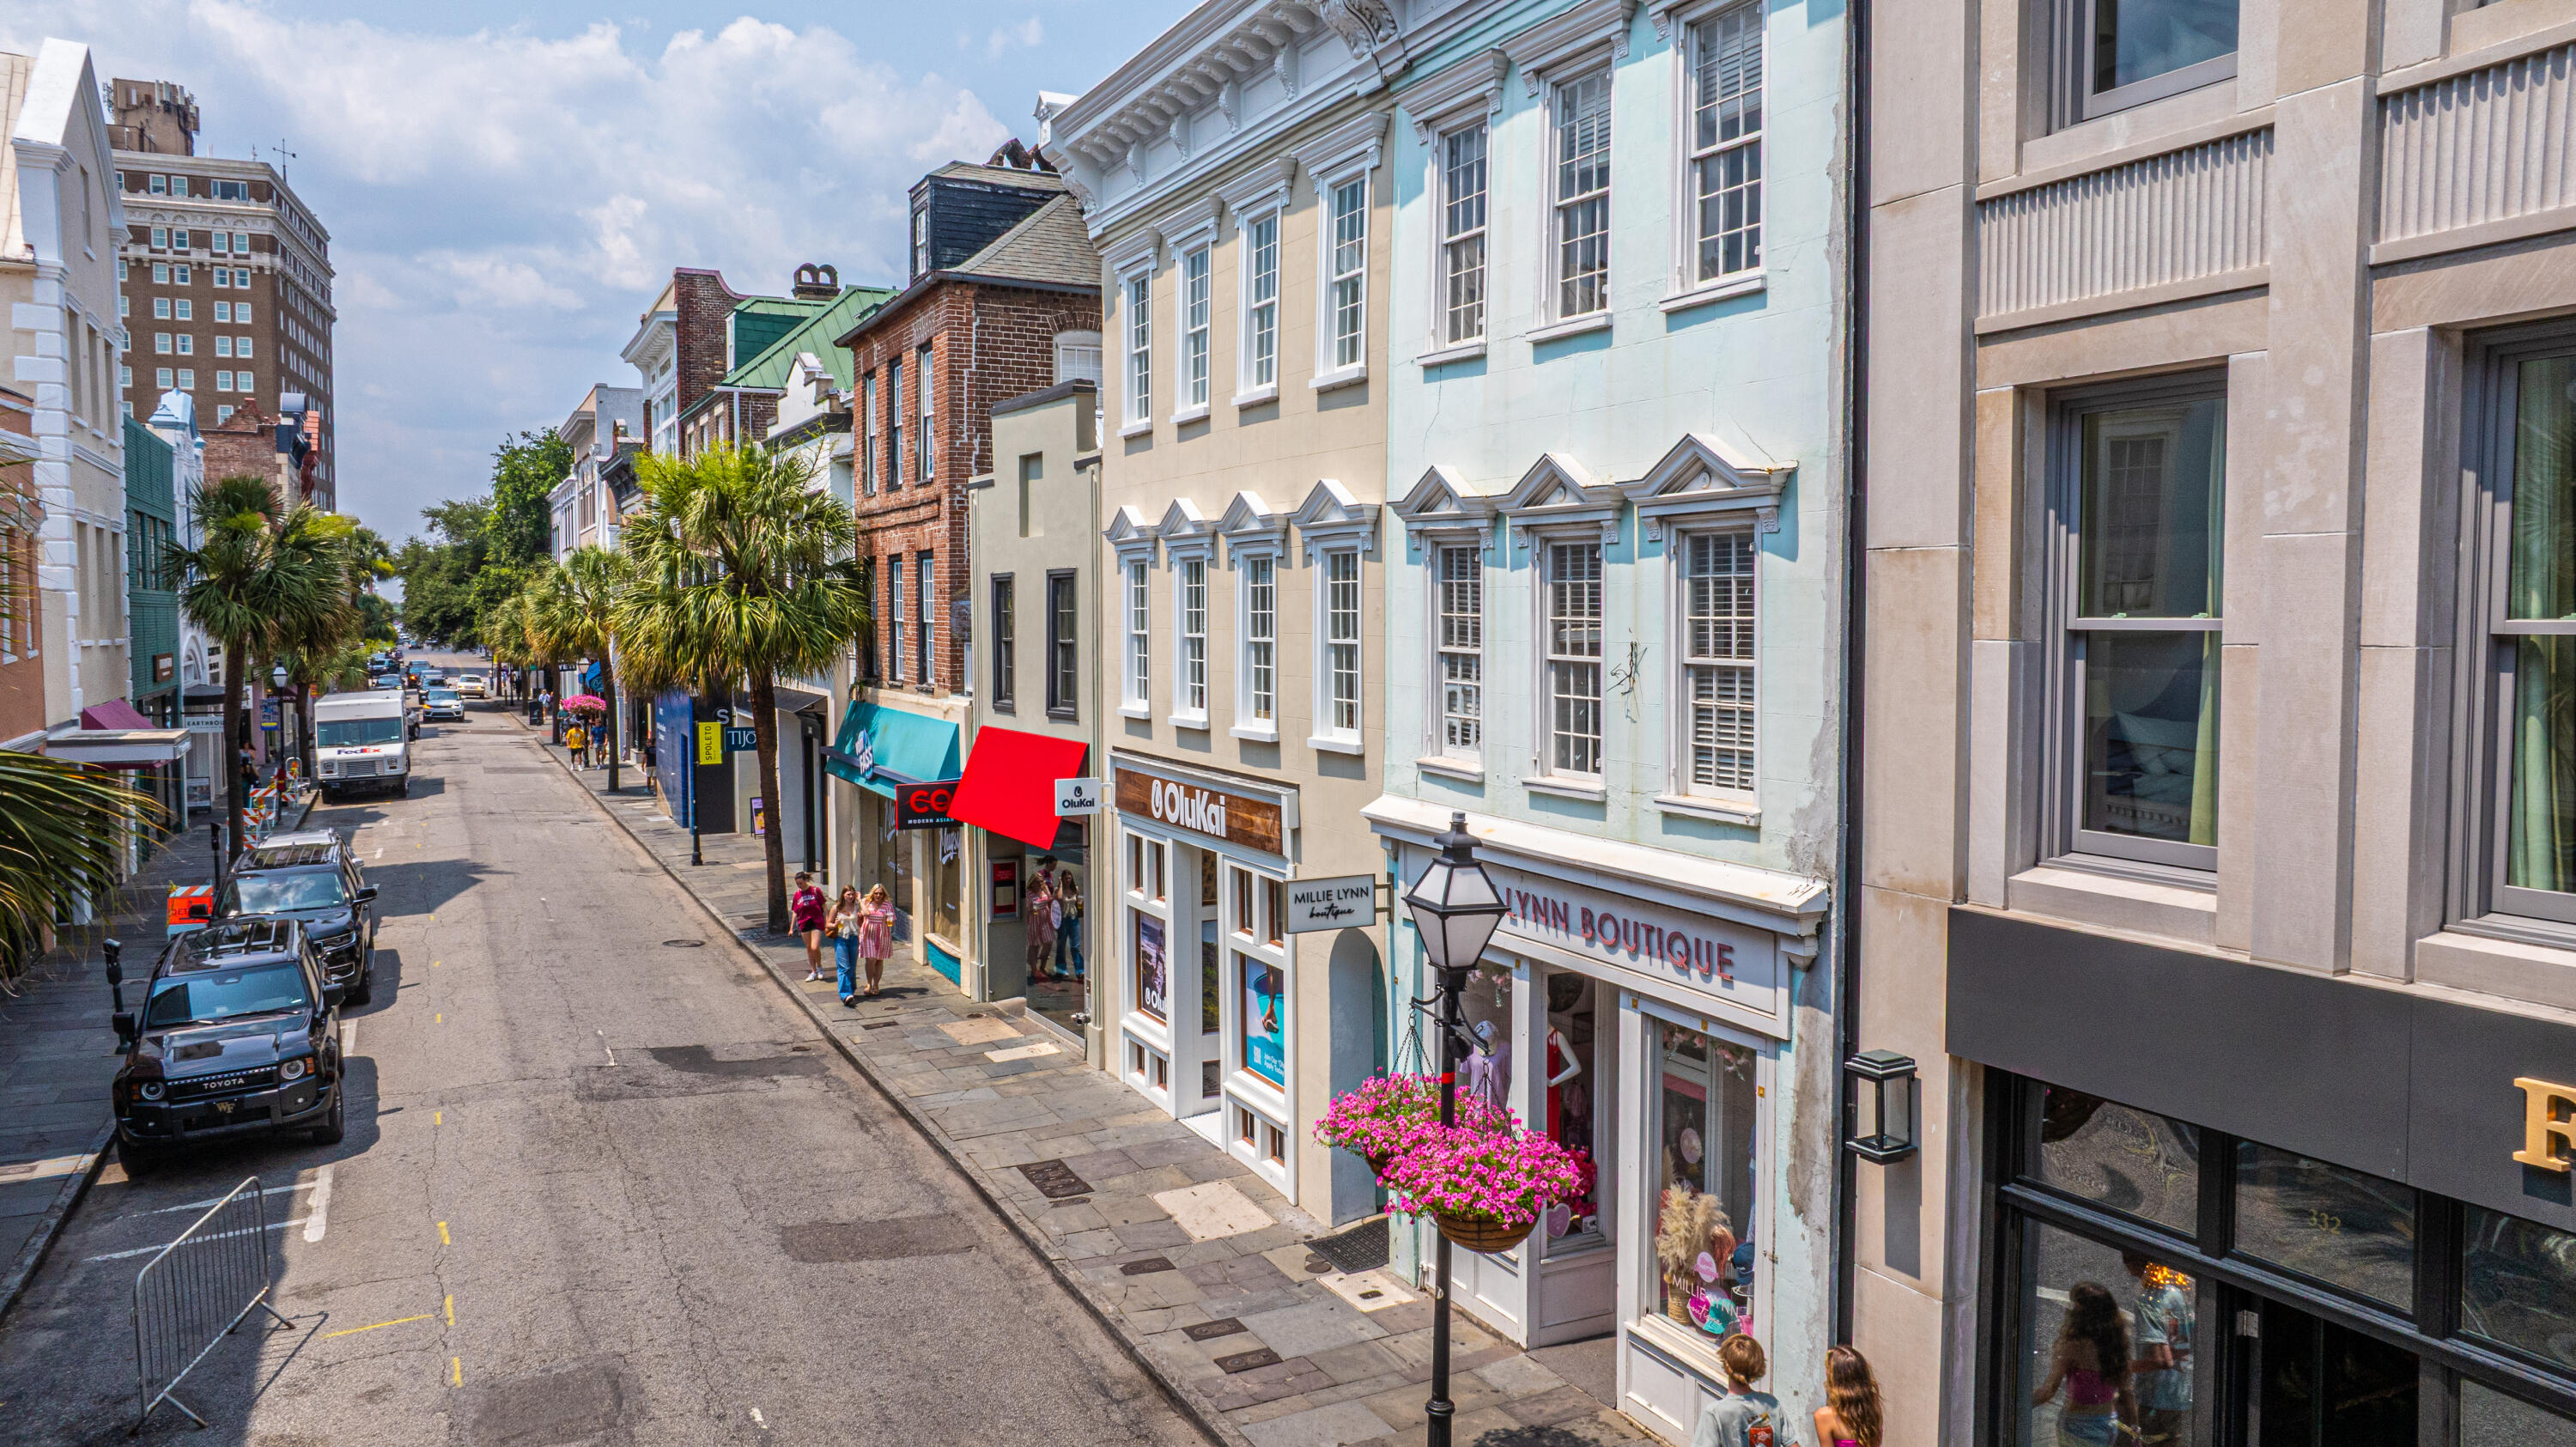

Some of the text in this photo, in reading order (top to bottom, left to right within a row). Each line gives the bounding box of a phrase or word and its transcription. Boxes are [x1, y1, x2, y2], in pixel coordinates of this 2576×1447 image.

[704, 726, 713, 761] SPOLETO
[1062, 799, 1095, 808] OluKai
[1164, 782, 1226, 838] OluKai
[1294, 886, 1369, 904] MILLIE LYNN
[1309, 903, 1355, 921] boutique
[1505, 888, 1734, 981] LYNN BOUTIQUE
[203, 1078, 245, 1090] TOYOTA
[216, 1102, 235, 1114] WF
[2309, 1208, 2342, 1235] 332
[1672, 1274, 1739, 1317] MILLIE LYNN
